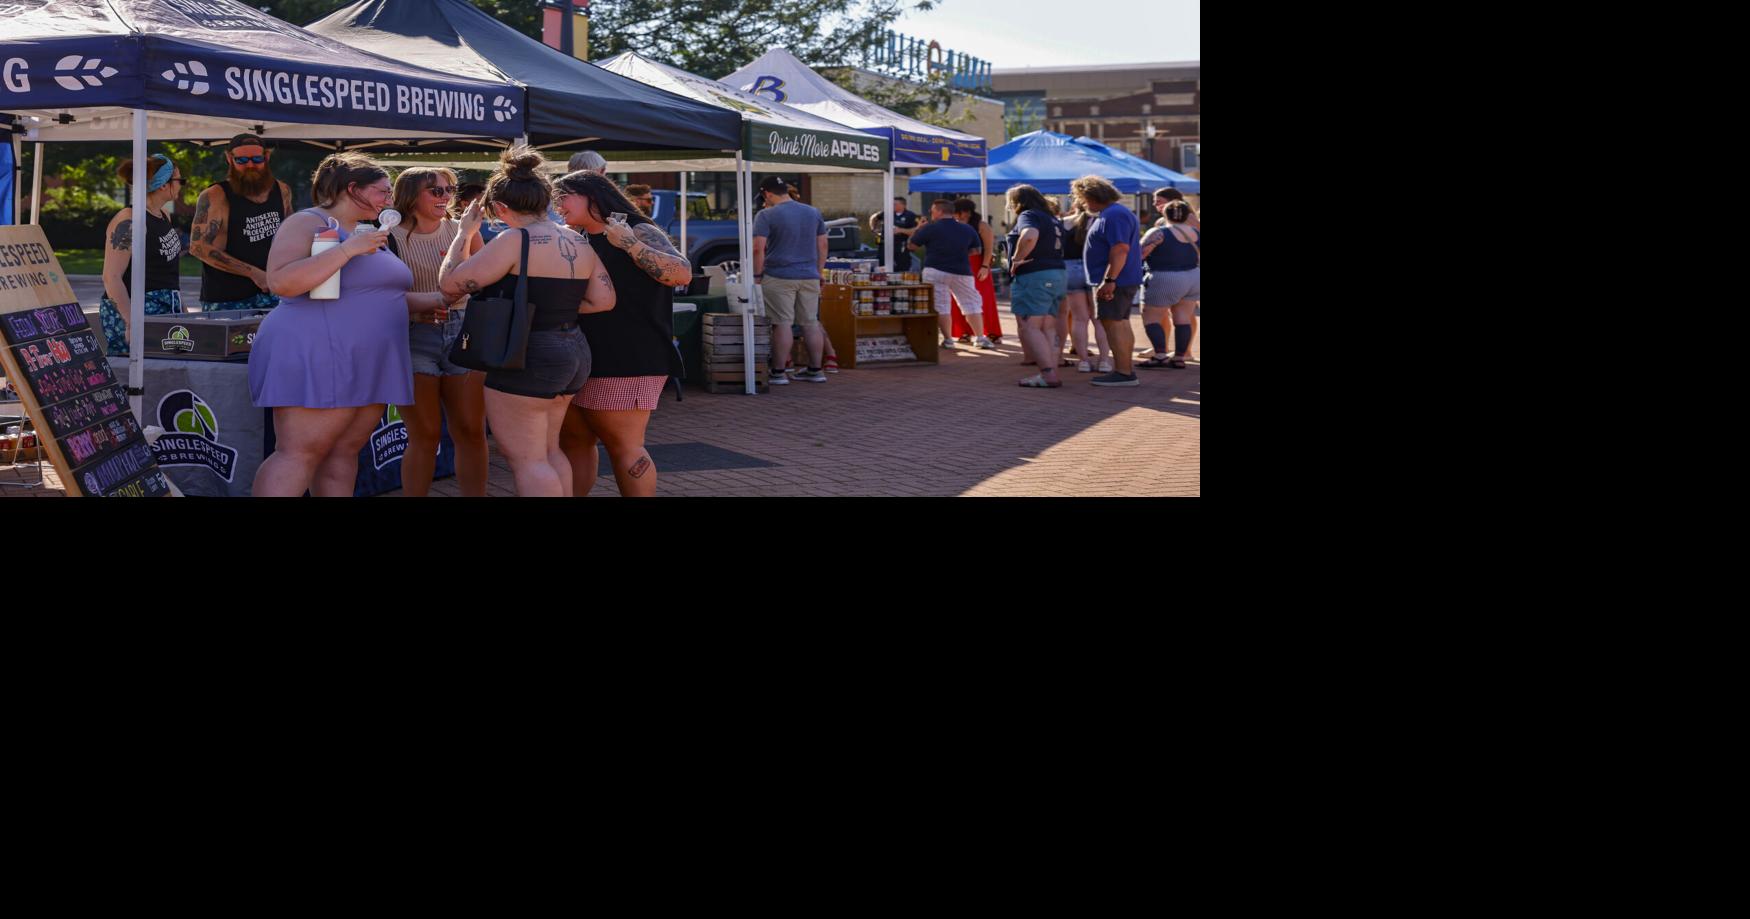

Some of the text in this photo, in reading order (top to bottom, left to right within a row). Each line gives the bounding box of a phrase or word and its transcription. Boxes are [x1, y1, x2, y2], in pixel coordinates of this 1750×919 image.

[224, 66, 485, 121] SINGLESPEED BREWING
[769, 130, 800, 155] Drink
[800, 133, 829, 158] More
[830, 139, 880, 162] APPLES
[152, 438, 229, 465] SINGLESPEED
[383, 442, 409, 457] BREW
